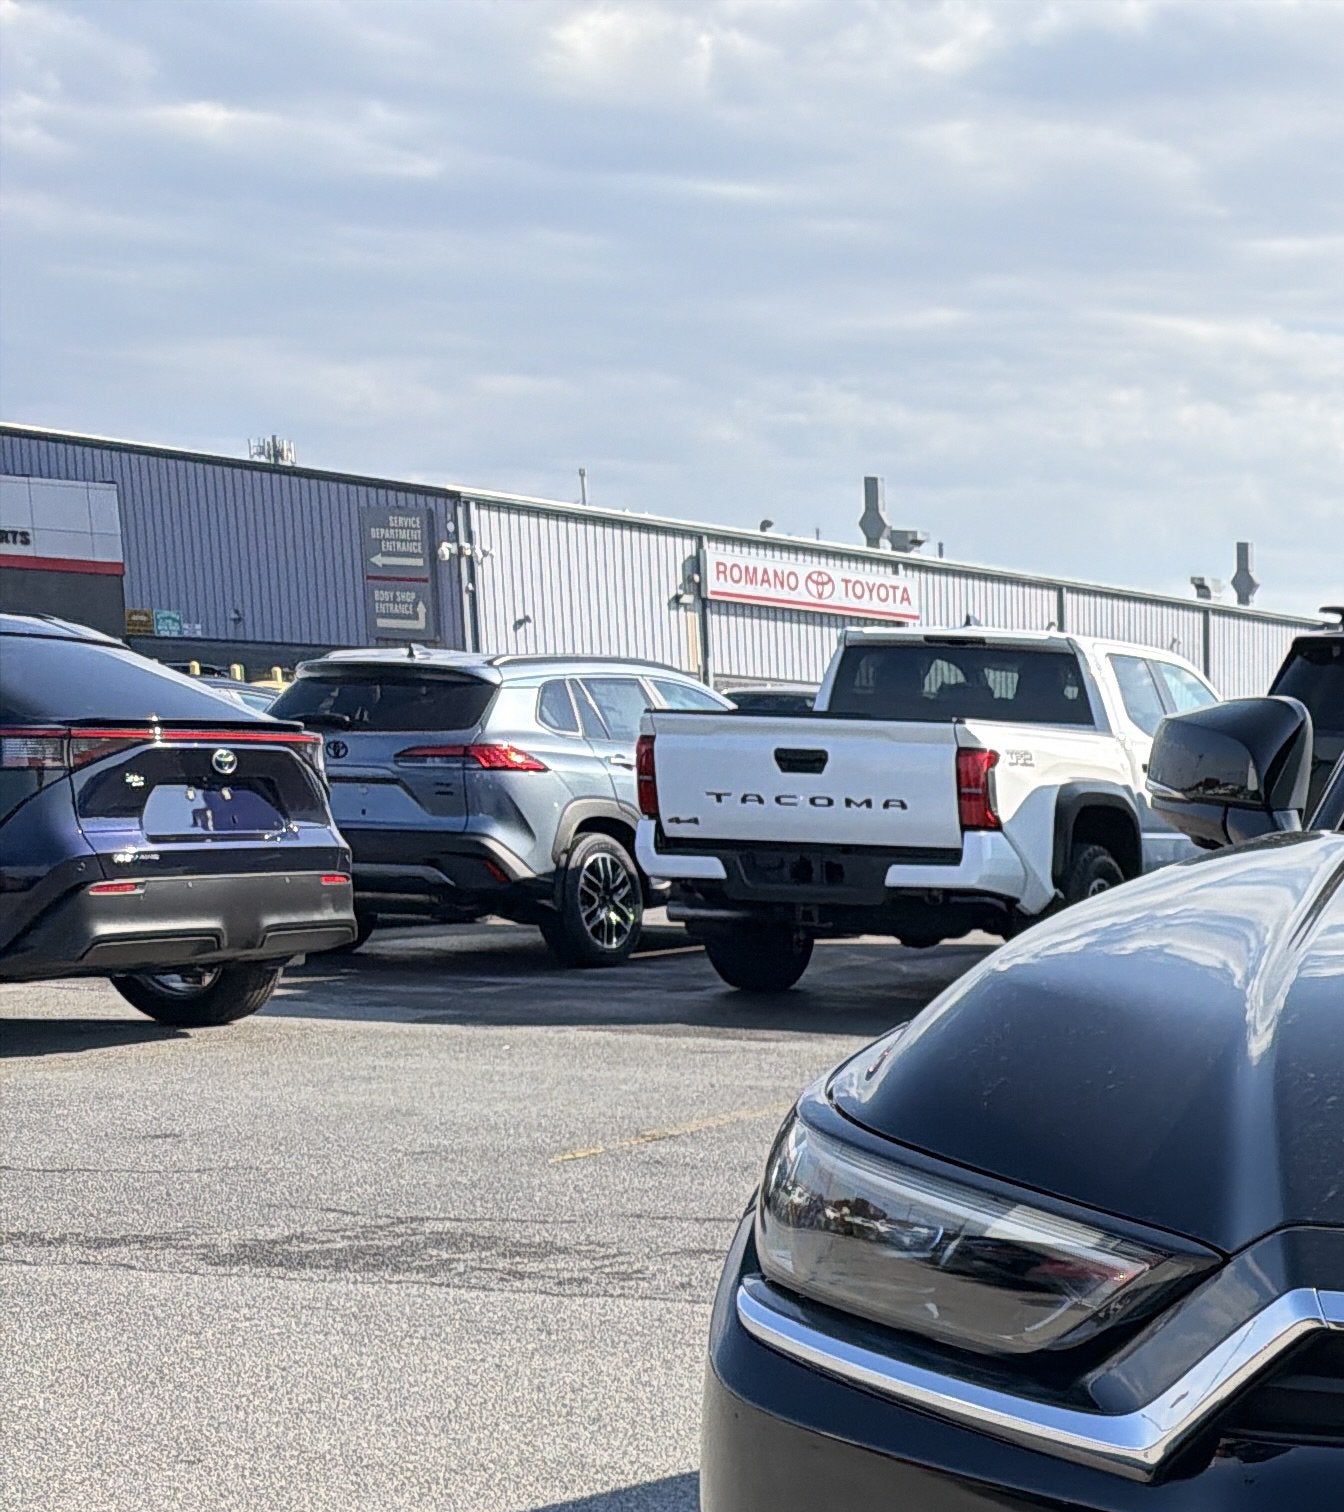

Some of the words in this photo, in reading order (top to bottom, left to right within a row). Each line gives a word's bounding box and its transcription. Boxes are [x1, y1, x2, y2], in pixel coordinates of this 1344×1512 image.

[389, 516, 420, 528] SERVICE
[371, 528, 421, 540] DEPARTMENT
[382, 541, 422, 553] ENTRANCE
[715, 561, 799, 591] ROMANO
[841, 578, 911, 606] TOYOTA
[374, 590, 394, 601] BODY
[395, 591, 416, 602] SHOP
[375, 603, 414, 615] ENTRANCE
[705, 791, 908, 810] TACOMA
